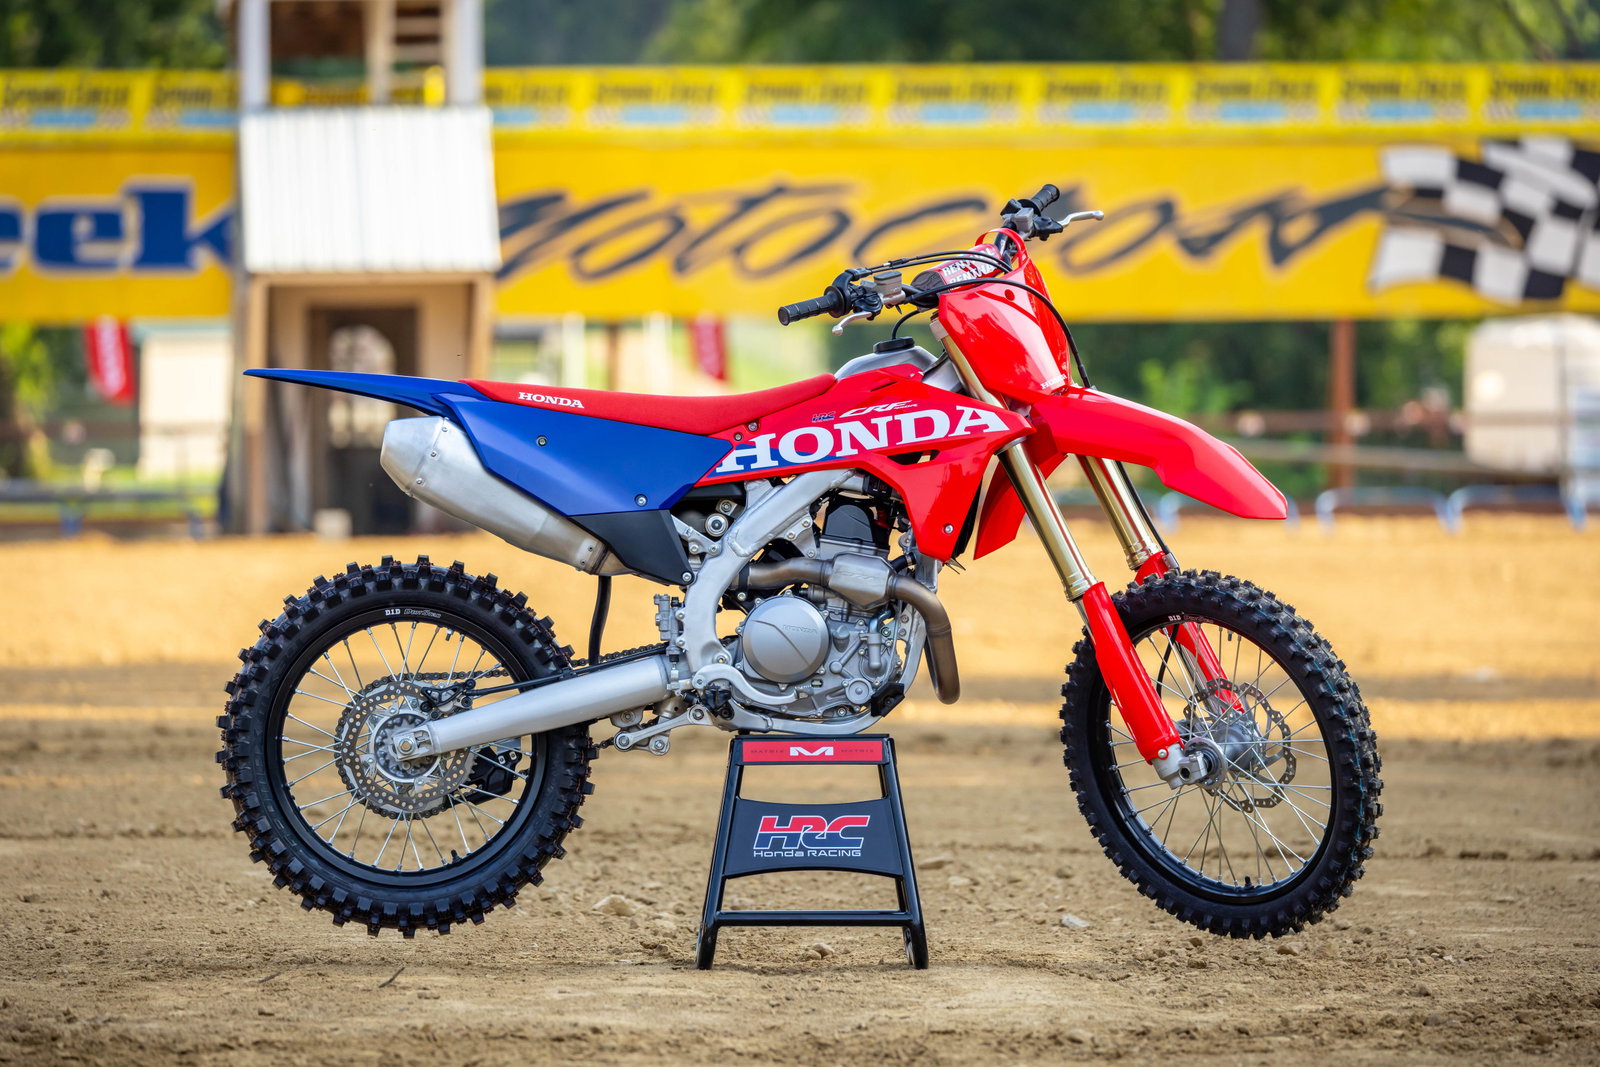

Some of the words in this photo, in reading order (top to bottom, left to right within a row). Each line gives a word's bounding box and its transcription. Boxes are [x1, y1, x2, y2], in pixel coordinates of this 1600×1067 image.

[518, 392, 585, 409] HONDA
[839, 400, 913, 418] CRF
[715, 405, 1010, 473] HONDA
[753, 815, 871, 850] HRC
